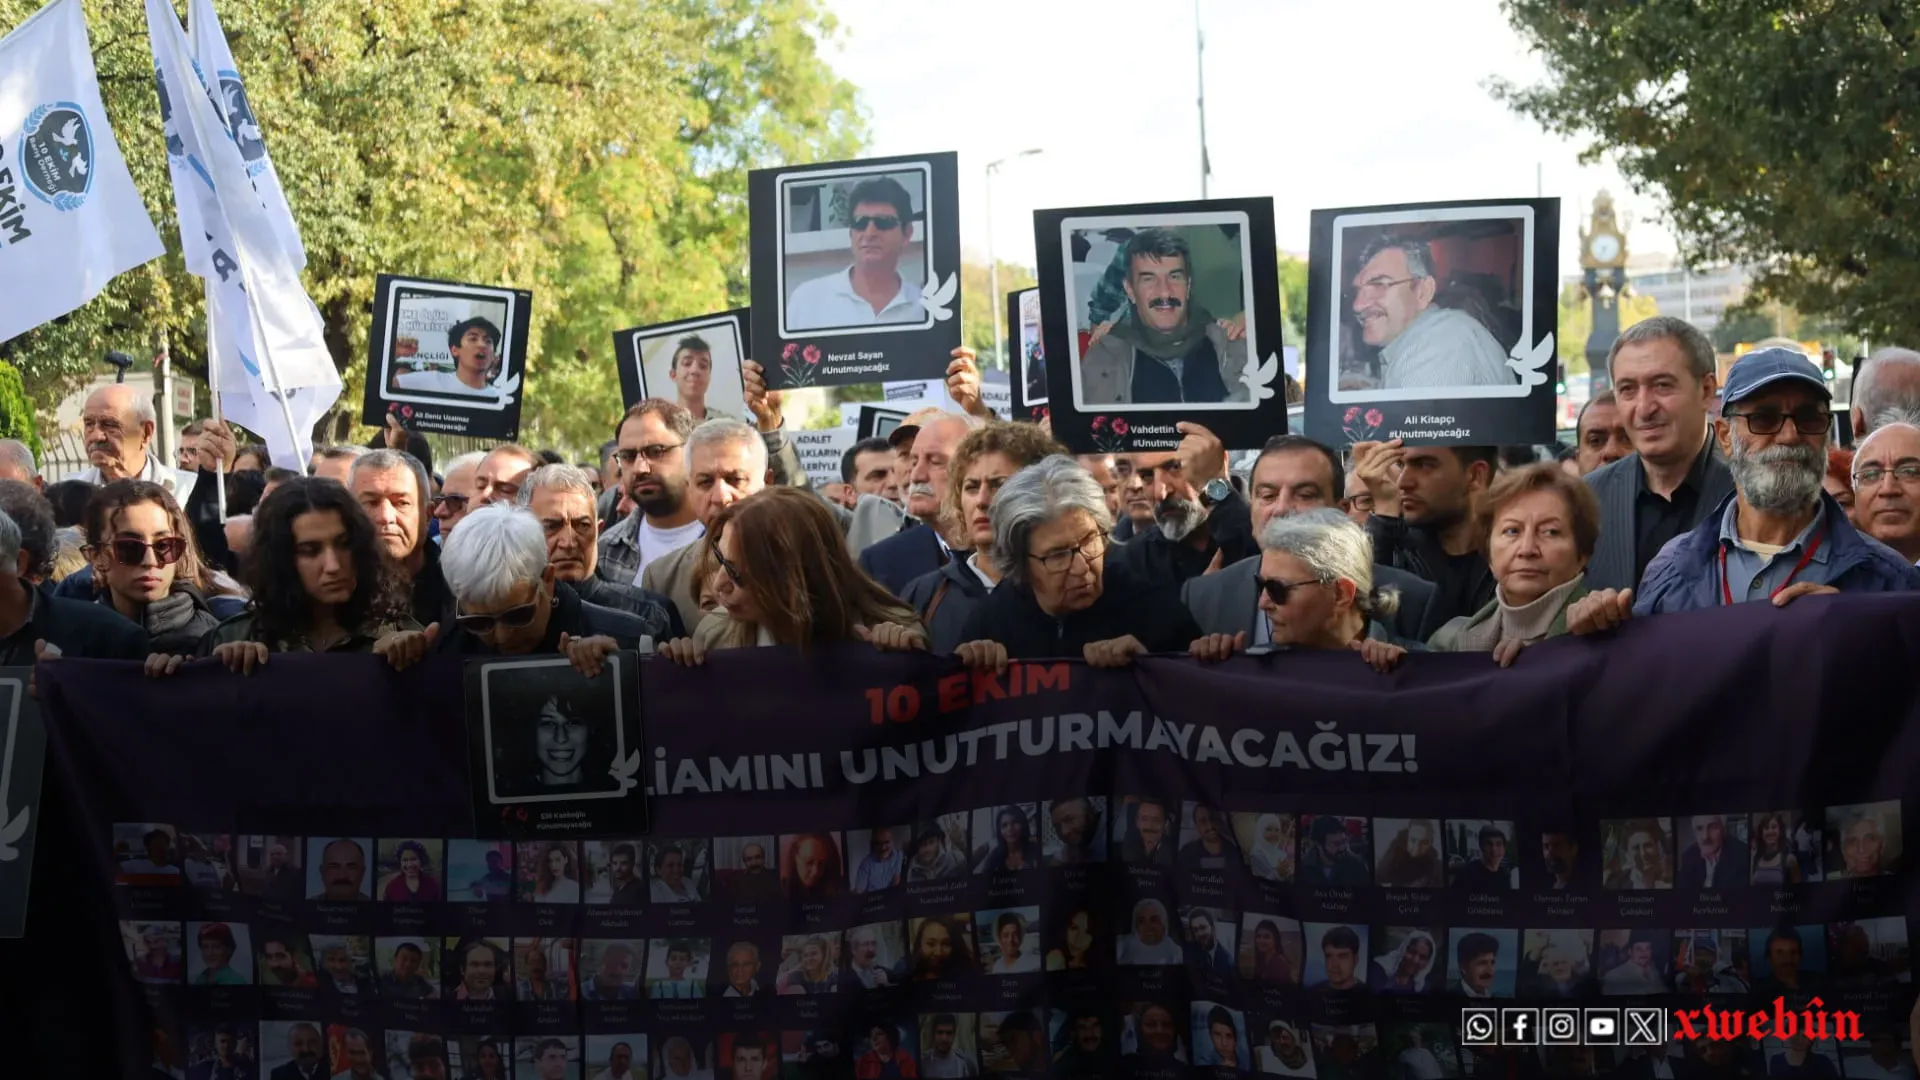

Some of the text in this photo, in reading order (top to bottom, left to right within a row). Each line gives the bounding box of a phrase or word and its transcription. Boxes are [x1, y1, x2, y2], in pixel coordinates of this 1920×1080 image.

[827, 351, 884, 362] Nevzat Sayan
[821, 362, 890, 375] #Unutmayacağız
[1404, 414, 1456, 426] Ali Kitapçı
[1130, 424, 1175, 434] Vahdettin
[1388, 427, 1471, 439] #Unutmayacağız
[796, 435, 833, 444] ADALET
[864, 685, 921, 725] 10
[839, 710, 1419, 785] UNUTTURMAYACAĞIZ!
